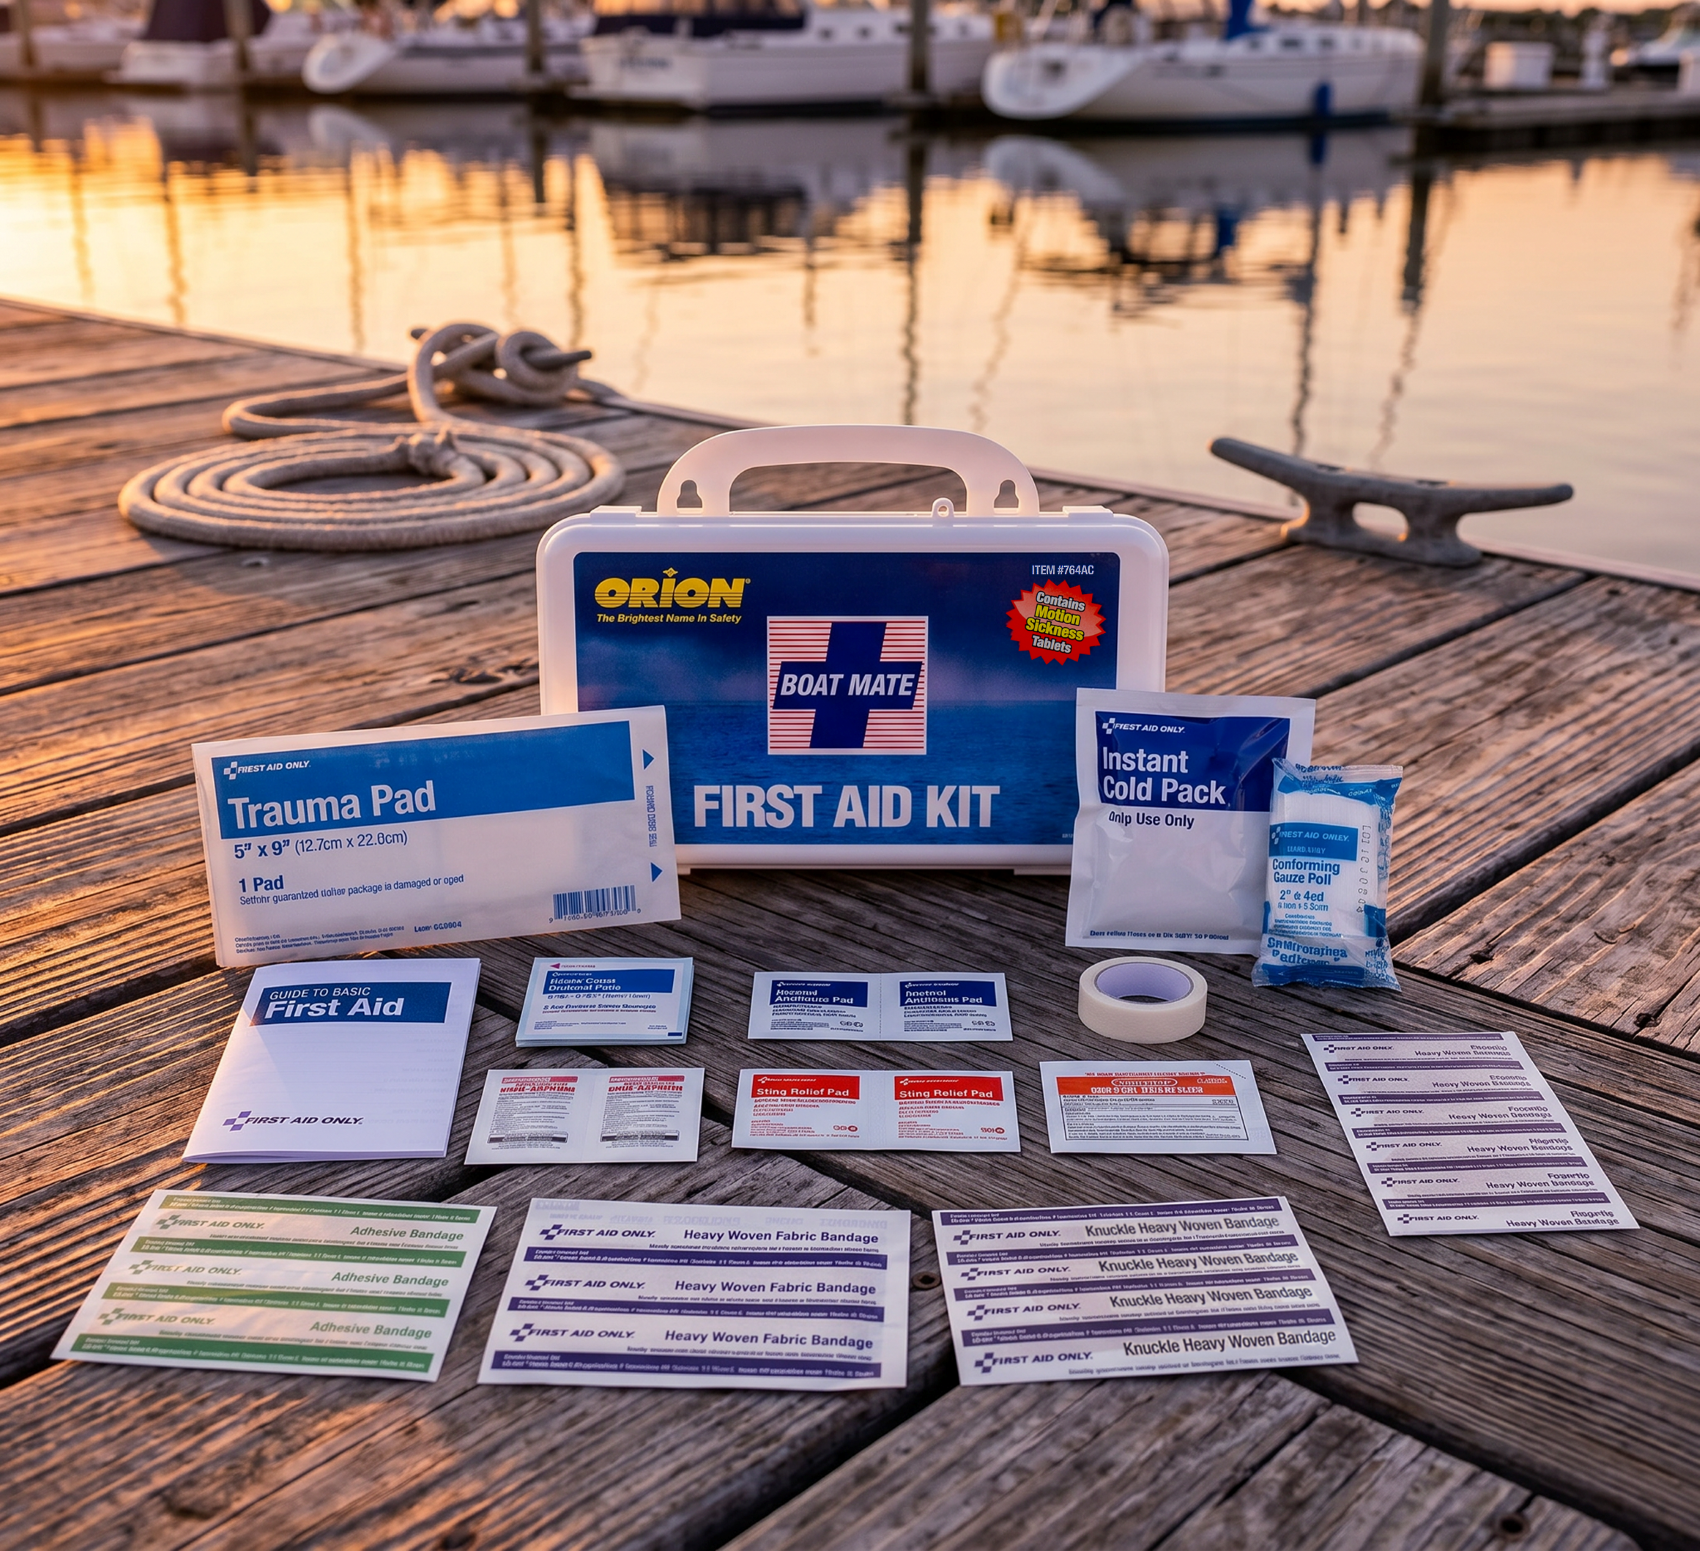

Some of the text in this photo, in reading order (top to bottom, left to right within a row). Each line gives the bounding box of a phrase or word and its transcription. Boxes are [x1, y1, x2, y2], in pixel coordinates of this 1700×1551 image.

[1032, 565, 1095, 575] ITEM #764AC
[594, 576, 746, 609] ORION
[1036, 591, 1086, 612] Contains
[596, 614, 742, 625] The Brightest Name In Safety
[1034, 604, 1082, 626] Motion
[1025, 618, 1085, 642] Sickness
[1032, 635, 1072, 654] Tablets
[780, 674, 916, 696] BOAT MATE
[1142, 724, 1159, 732] AID
[266, 762, 283, 772] AID
[1102, 746, 1189, 774] Instant
[1103, 775, 1226, 805] Cold Pack
[228, 780, 437, 830] Trauma Pad
[694, 784, 823, 829] FIRST
[832, 785, 913, 828] AID
[926, 785, 1001, 828] KIT
[1136, 812, 1161, 826] Use
[1164, 814, 1195, 830] Only
[257, 845, 267, 857] x
[294, 836, 343, 856] (12.7cm
[346, 836, 355, 848] x
[1272, 858, 1341, 876] Conforming
[238, 874, 285, 893] 1 Pad
[1274, 872, 1332, 886] Gauze Poll
[348, 883, 383, 896] package
[394, 878, 432, 892] damaged
[433, 878, 442, 887] or
[1304, 890, 1325, 902] 4ed
[269, 986, 372, 1000] GUIDE TO BASIC
[832, 996, 854, 1004] Pad
[962, 996, 983, 1004] Pad
[264, 997, 405, 1020] First Aid
[756, 1088, 787, 1097] Sting
[828, 1088, 850, 1097] Pad
[900, 1090, 993, 1099] Sting Relief Pad
[245, 1116, 290, 1125] FIRST
[290, 1116, 318, 1125] AID
[1497, 1144, 1529, 1152] Woven
[175, 1219, 209, 1227] FIRST
[208, 1220, 230, 1228] AID
[1084, 1216, 1280, 1238] Knuckle Heavy Woven Bandage
[1506, 1220, 1537, 1228] Heavy
[1538, 1219, 1574, 1227] Woven
[350, 1226, 464, 1242] Adhesive Bandage
[556, 1229, 595, 1237] FIRST
[596, 1230, 619, 1238] AID
[684, 1230, 879, 1245] Heavy Woven Fabric Bandage
[968, 1232, 1004, 1240] FIRST
[1005, 1231, 1026, 1239] AID
[1098, 1251, 1299, 1273] Knuckle Heavy Woven Bandage
[182, 1266, 205, 1274] AID
[976, 1269, 1012, 1277] FIRST
[331, 1272, 449, 1288] Adhesive Bandage
[542, 1280, 582, 1288] FIRST
[582, 1280, 607, 1288] AID
[674, 1280, 877, 1296] Heavy Woven Fabric Bandage
[1109, 1286, 1313, 1308] Knuckle Heavy Woven Bandage
[984, 1307, 1020, 1316] FIRST
[1022, 1304, 1044, 1313] AID
[154, 1315, 179, 1323] AID
[310, 1322, 433, 1340] Adhesive Bandage
[528, 1328, 569, 1337] FIRST
[570, 1330, 595, 1338] AID
[664, 1330, 874, 1350] Heavy Woven Fabric Bandage
[1123, 1338, 1181, 1357] Knuckle
[1182, 1336, 1226, 1353] Heavy
[1228, 1332, 1276, 1349] Woven
[1277, 1328, 1337, 1346] Bandage
[992, 1356, 1029, 1366] FIRST
[1032, 1354, 1055, 1363] AID
